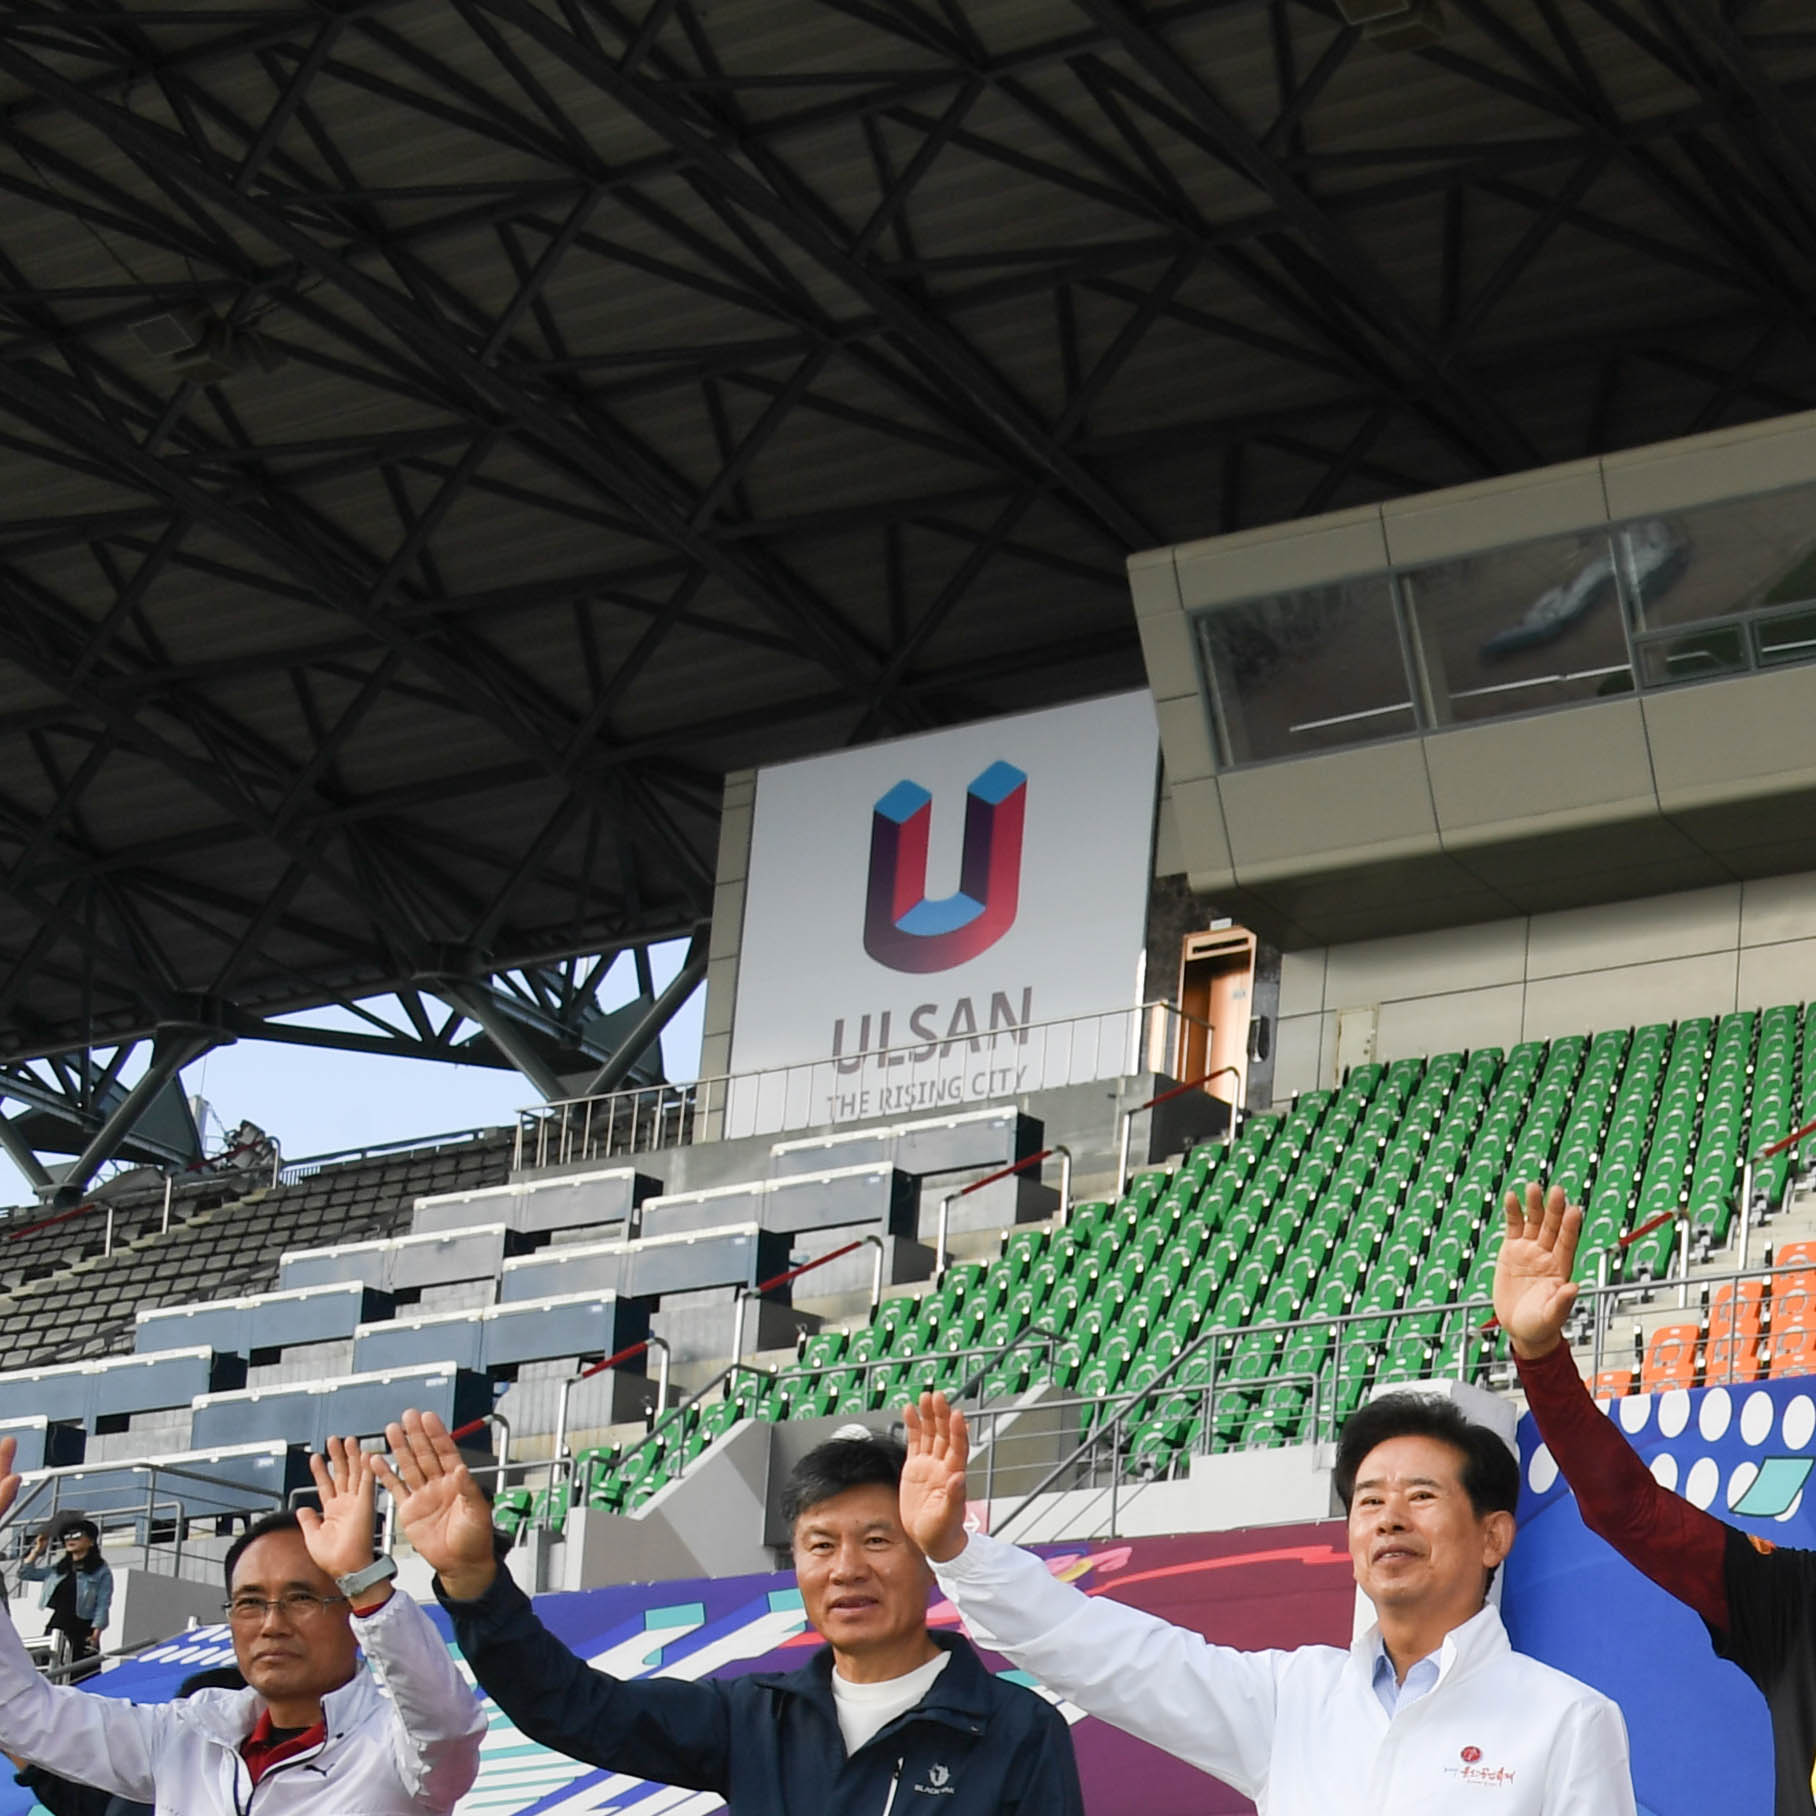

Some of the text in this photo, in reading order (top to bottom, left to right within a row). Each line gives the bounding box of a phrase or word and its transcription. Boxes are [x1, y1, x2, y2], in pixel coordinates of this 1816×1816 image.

[831, 986, 1032, 1075] ULSAN
[827, 1065, 1028, 1117] THE RISING CITY
